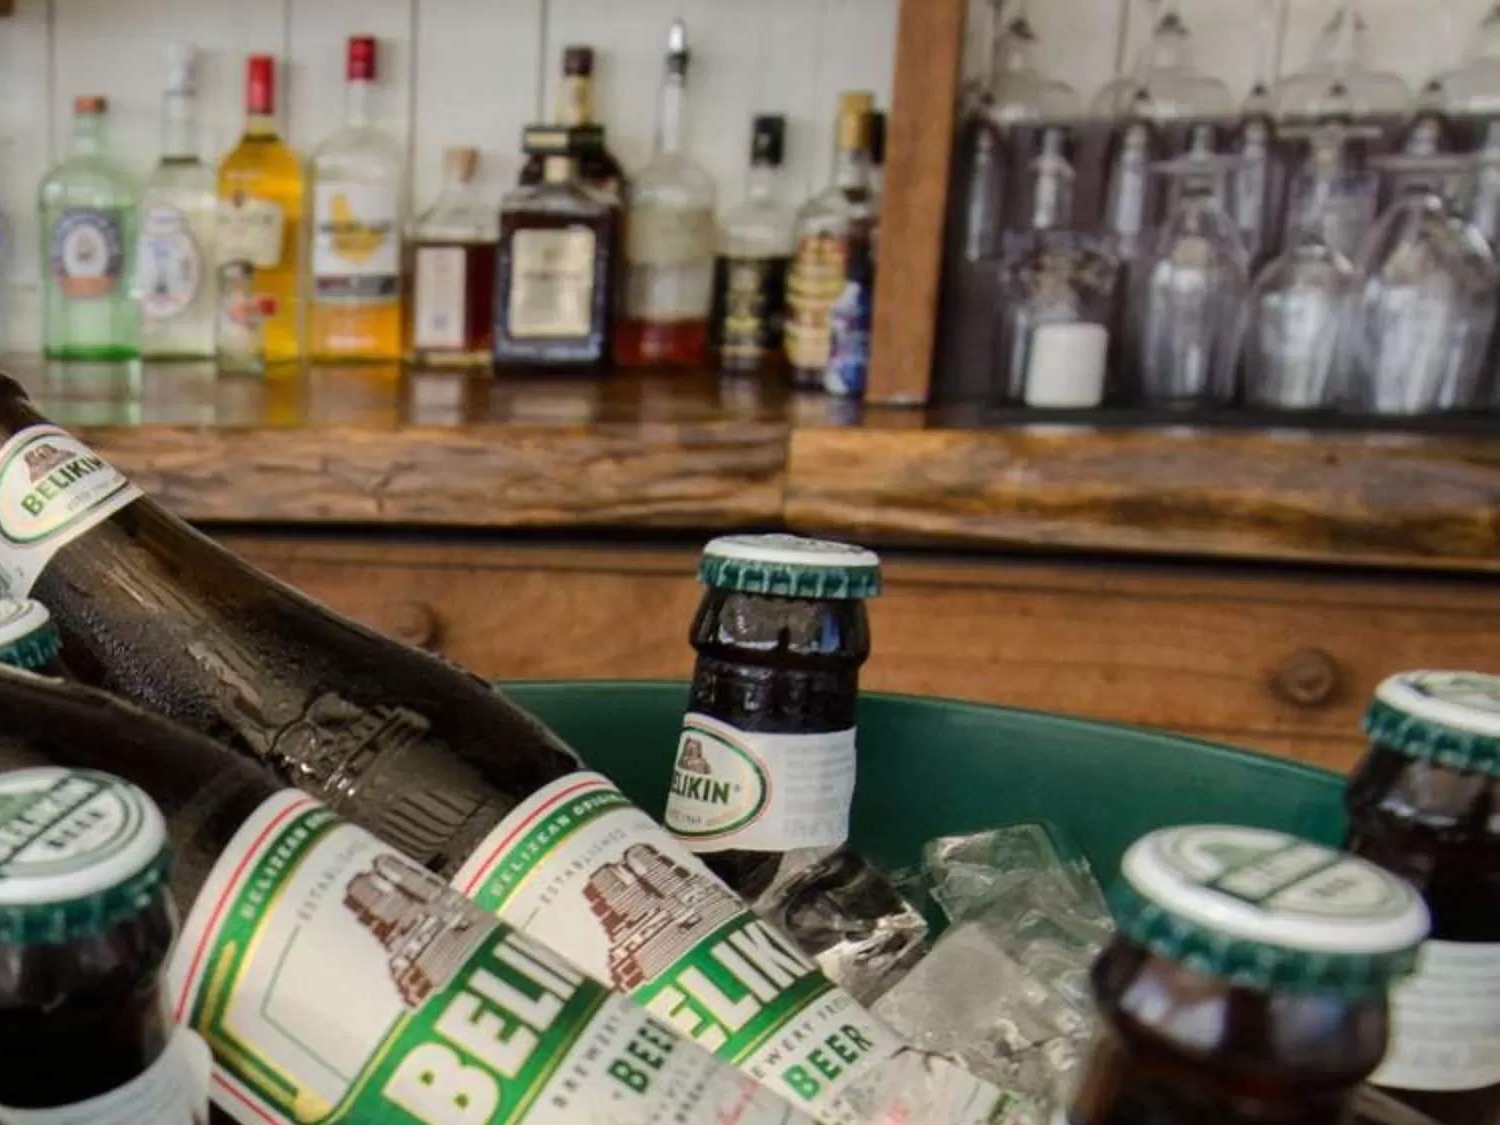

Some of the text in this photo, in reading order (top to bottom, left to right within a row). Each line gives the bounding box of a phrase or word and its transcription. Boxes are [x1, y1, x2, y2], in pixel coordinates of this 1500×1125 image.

[20, 456, 106, 517] BELIKIN
[669, 771, 732, 806] ELIKIN
[752, 1019, 817, 1081] EWERY
[782, 1022, 875, 1101] BEER
